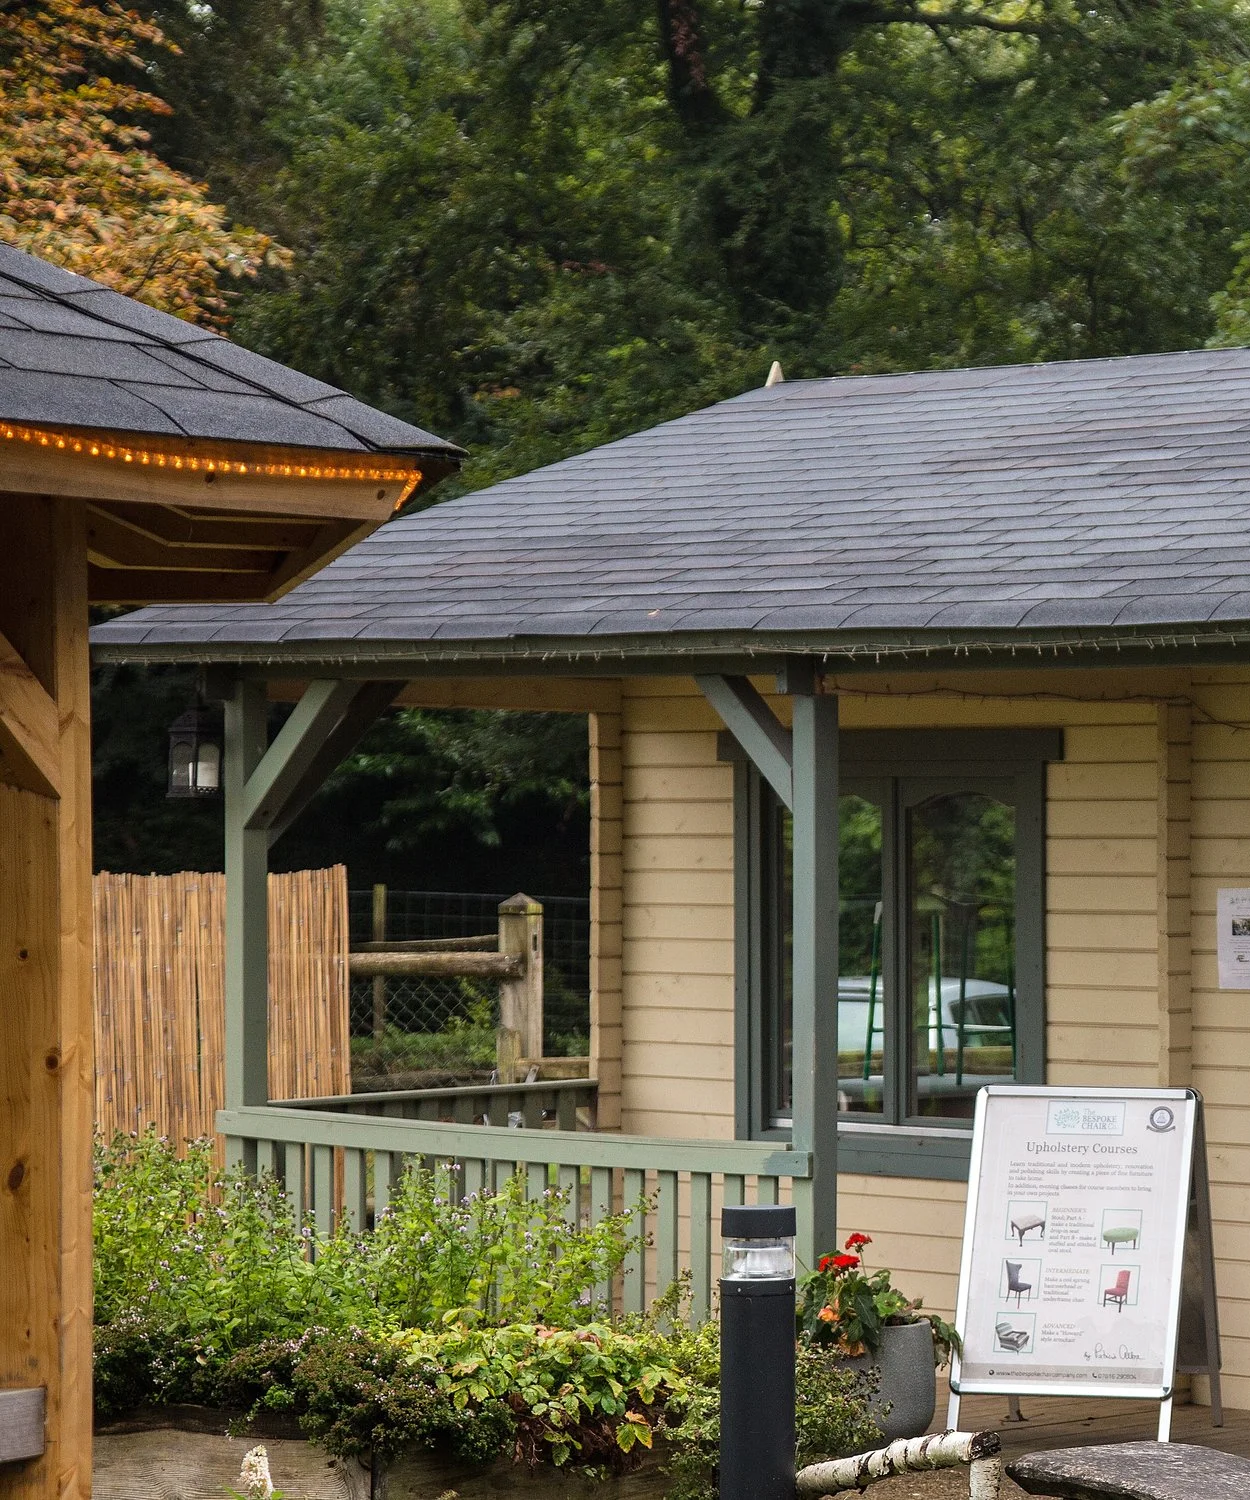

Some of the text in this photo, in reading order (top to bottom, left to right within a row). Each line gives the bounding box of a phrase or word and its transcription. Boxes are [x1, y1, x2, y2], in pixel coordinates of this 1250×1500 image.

[1082, 1115, 1118, 1123] BESPOKE
[1081, 1122, 1107, 1130] CHAIR
[1026, 1141, 1138, 1156] Upholstery Courses
[1020, 1168, 1045, 1176] polishing
